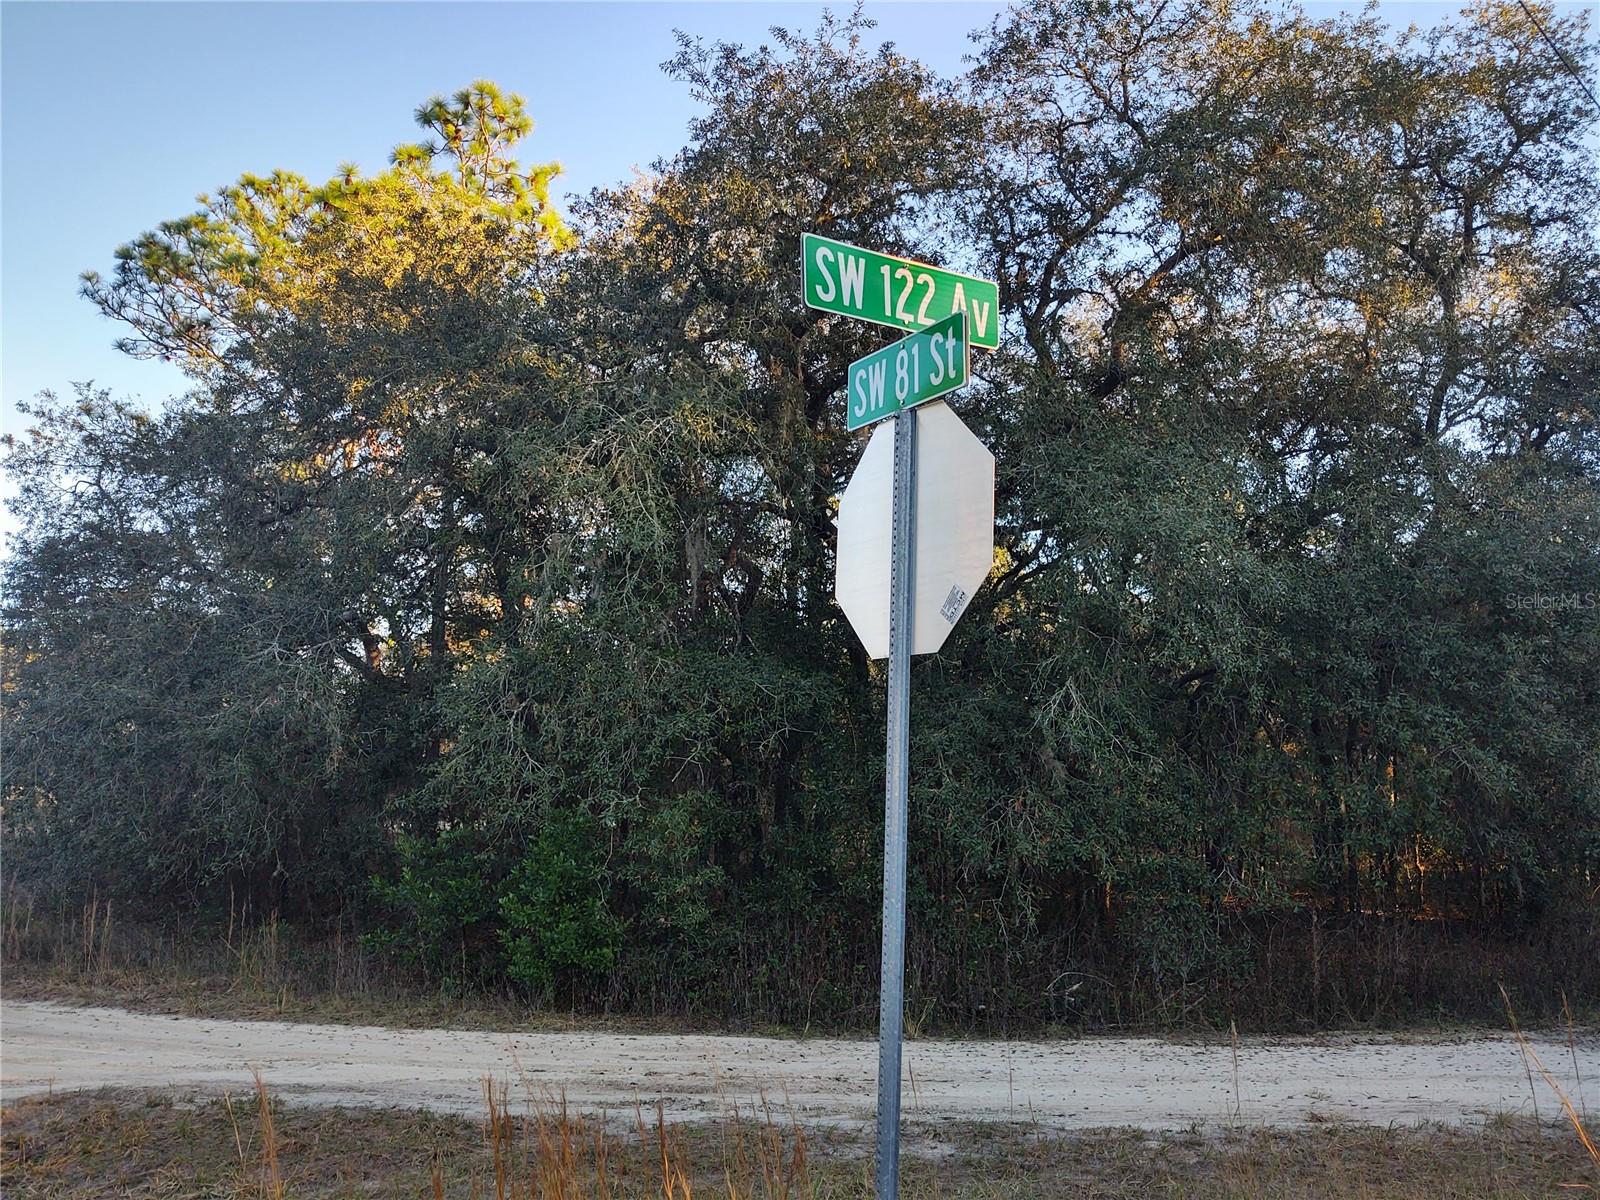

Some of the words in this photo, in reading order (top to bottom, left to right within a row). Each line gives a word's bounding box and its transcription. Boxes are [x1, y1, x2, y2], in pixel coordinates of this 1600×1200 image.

[815, 246, 866, 310] SW
[880, 264, 936, 326] 122
[951, 282, 990, 338] Av
[854, 358, 887, 418] SW
[895, 342, 919, 401] 81
[929, 326, 957, 386] St
